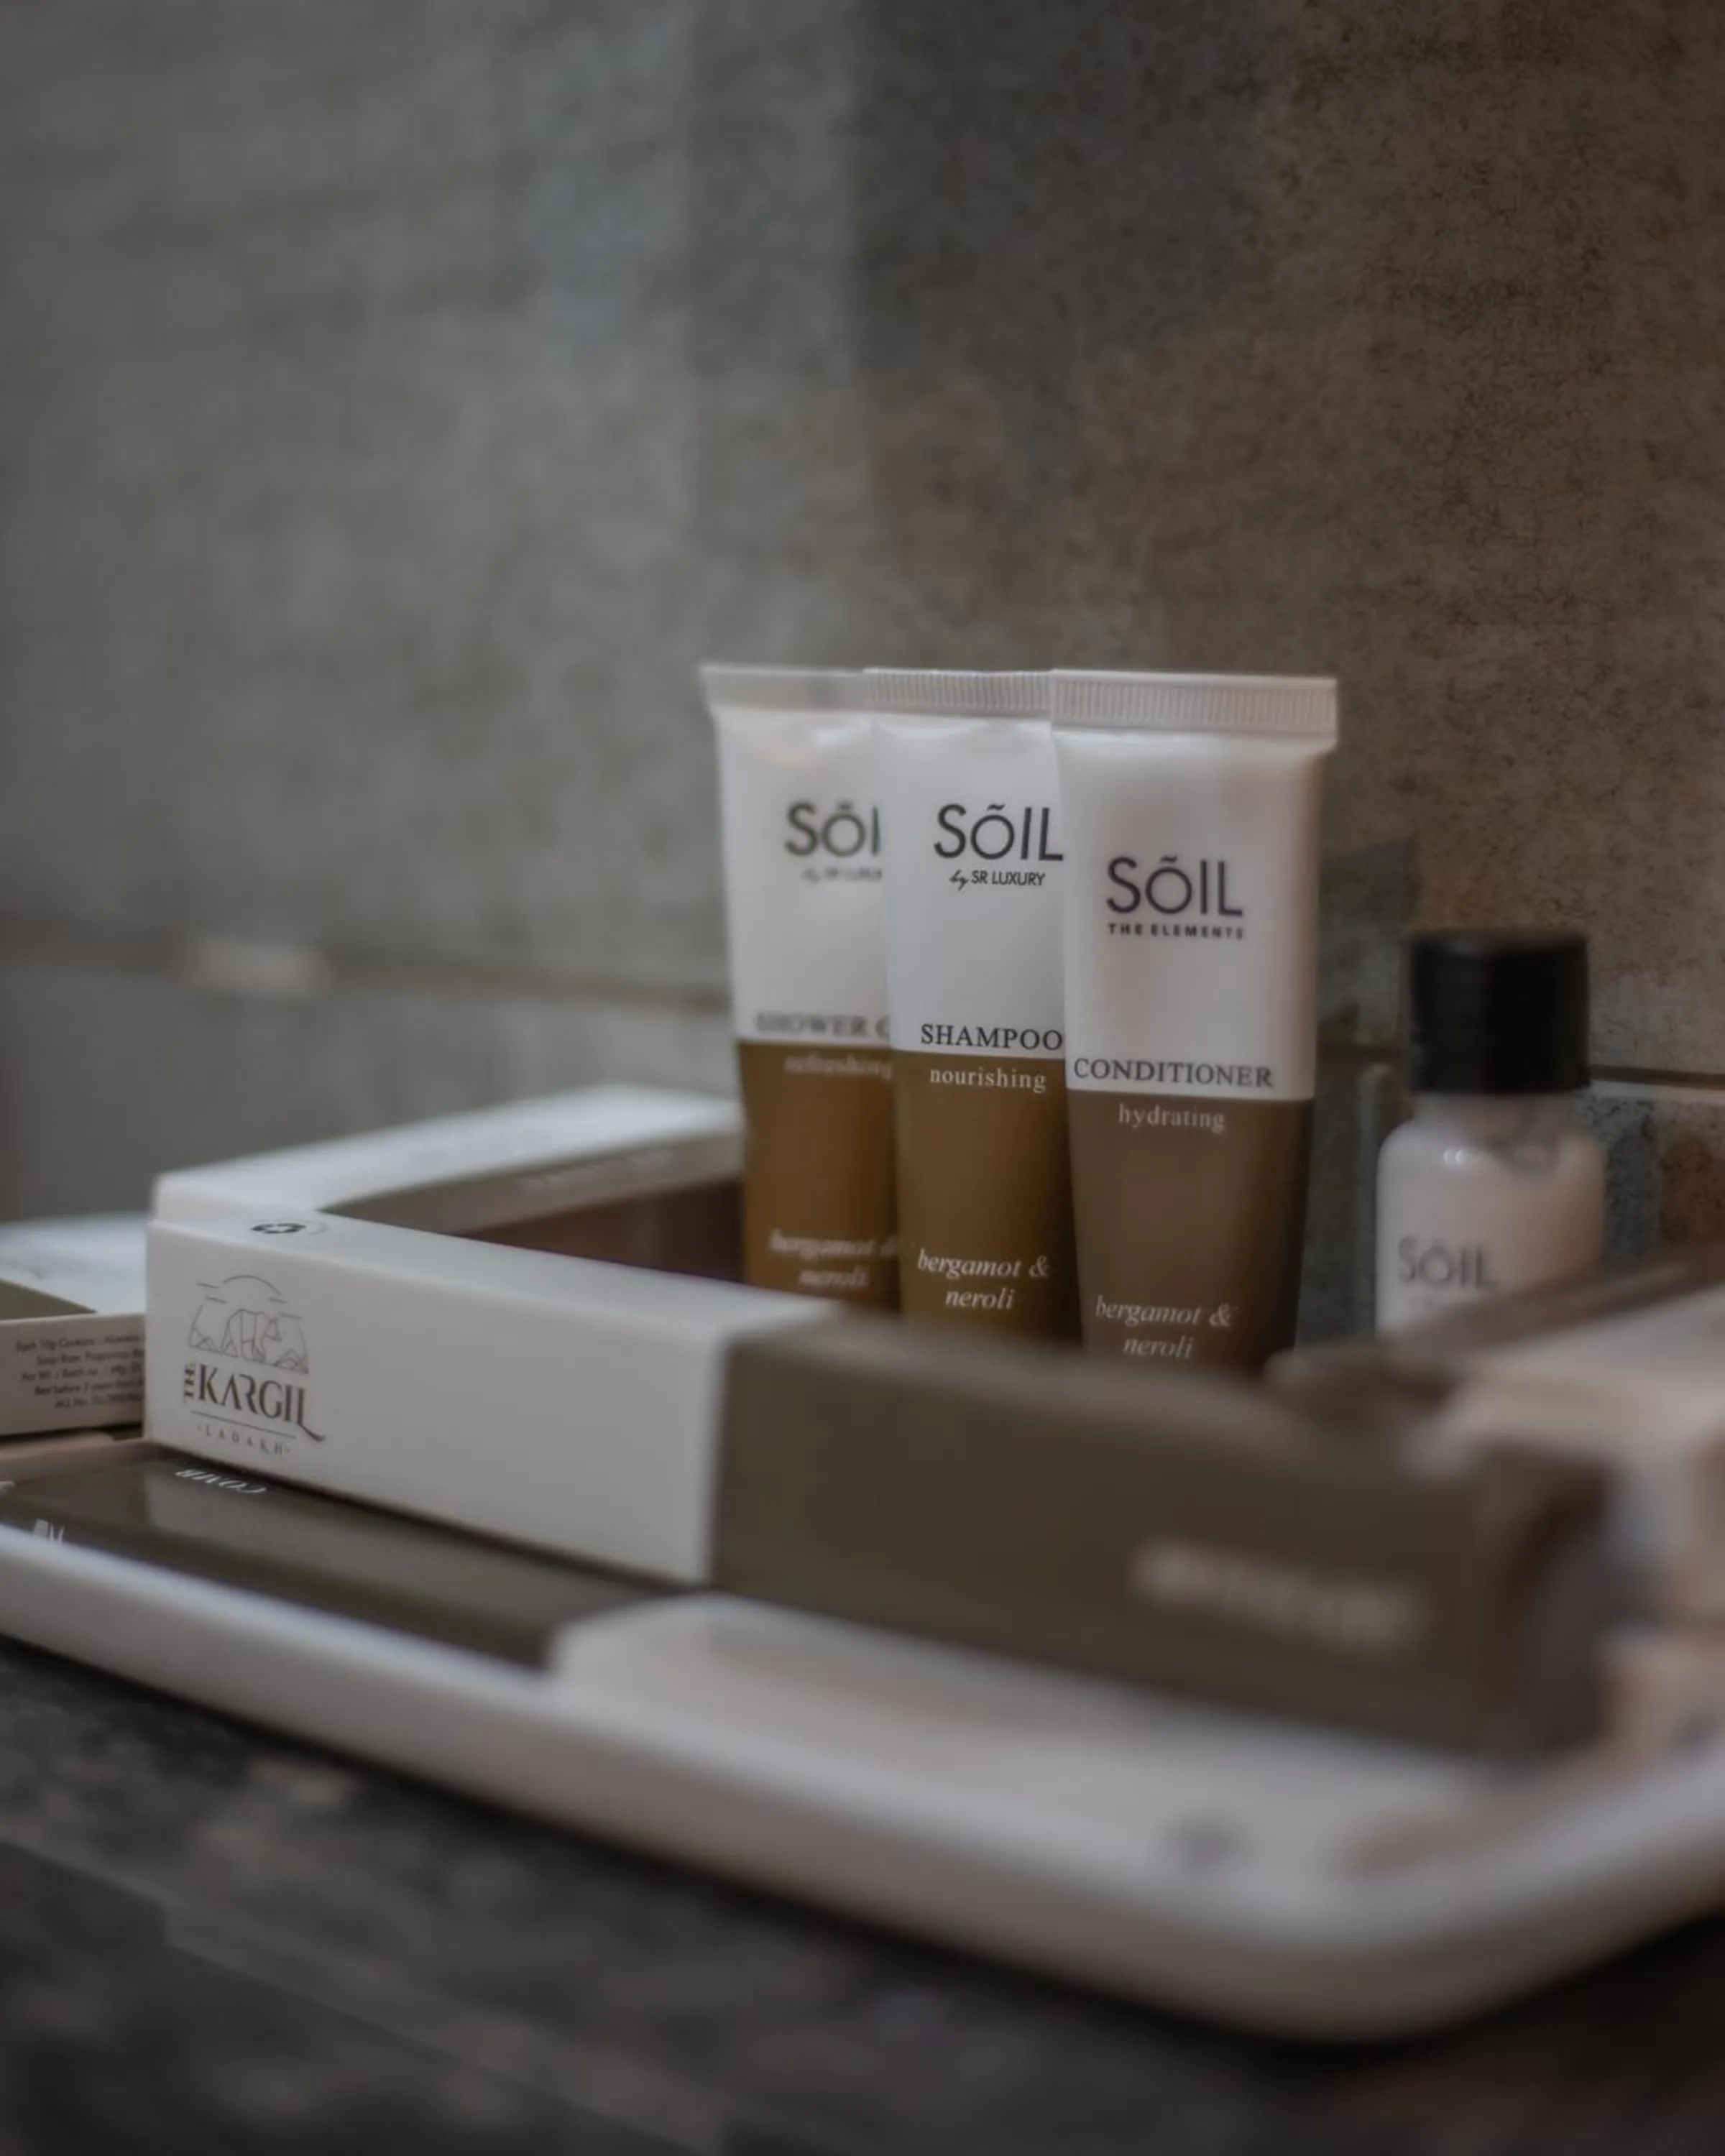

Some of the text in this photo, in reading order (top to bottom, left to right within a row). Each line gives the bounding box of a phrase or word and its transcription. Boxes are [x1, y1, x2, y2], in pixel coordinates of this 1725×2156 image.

[949, 870, 1046, 890] by SR LUXURY
[1108, 922, 1245, 940] THE ELEMENTS
[921, 1023, 1063, 1051] SHAMPOO
[930, 1067, 1046, 1092] nourishing
[1074, 1057, 1275, 1089] CONDITIONER
[1118, 1102, 1226, 1133] hydrating
[917, 1248, 1049, 1280] bergamot &
[944, 1287, 1015, 1310] neroli
[1095, 1294, 1233, 1327] bergamot &
[1123, 1335, 1195, 1360] neroli
[199, 1364, 326, 1442] KARGIL
